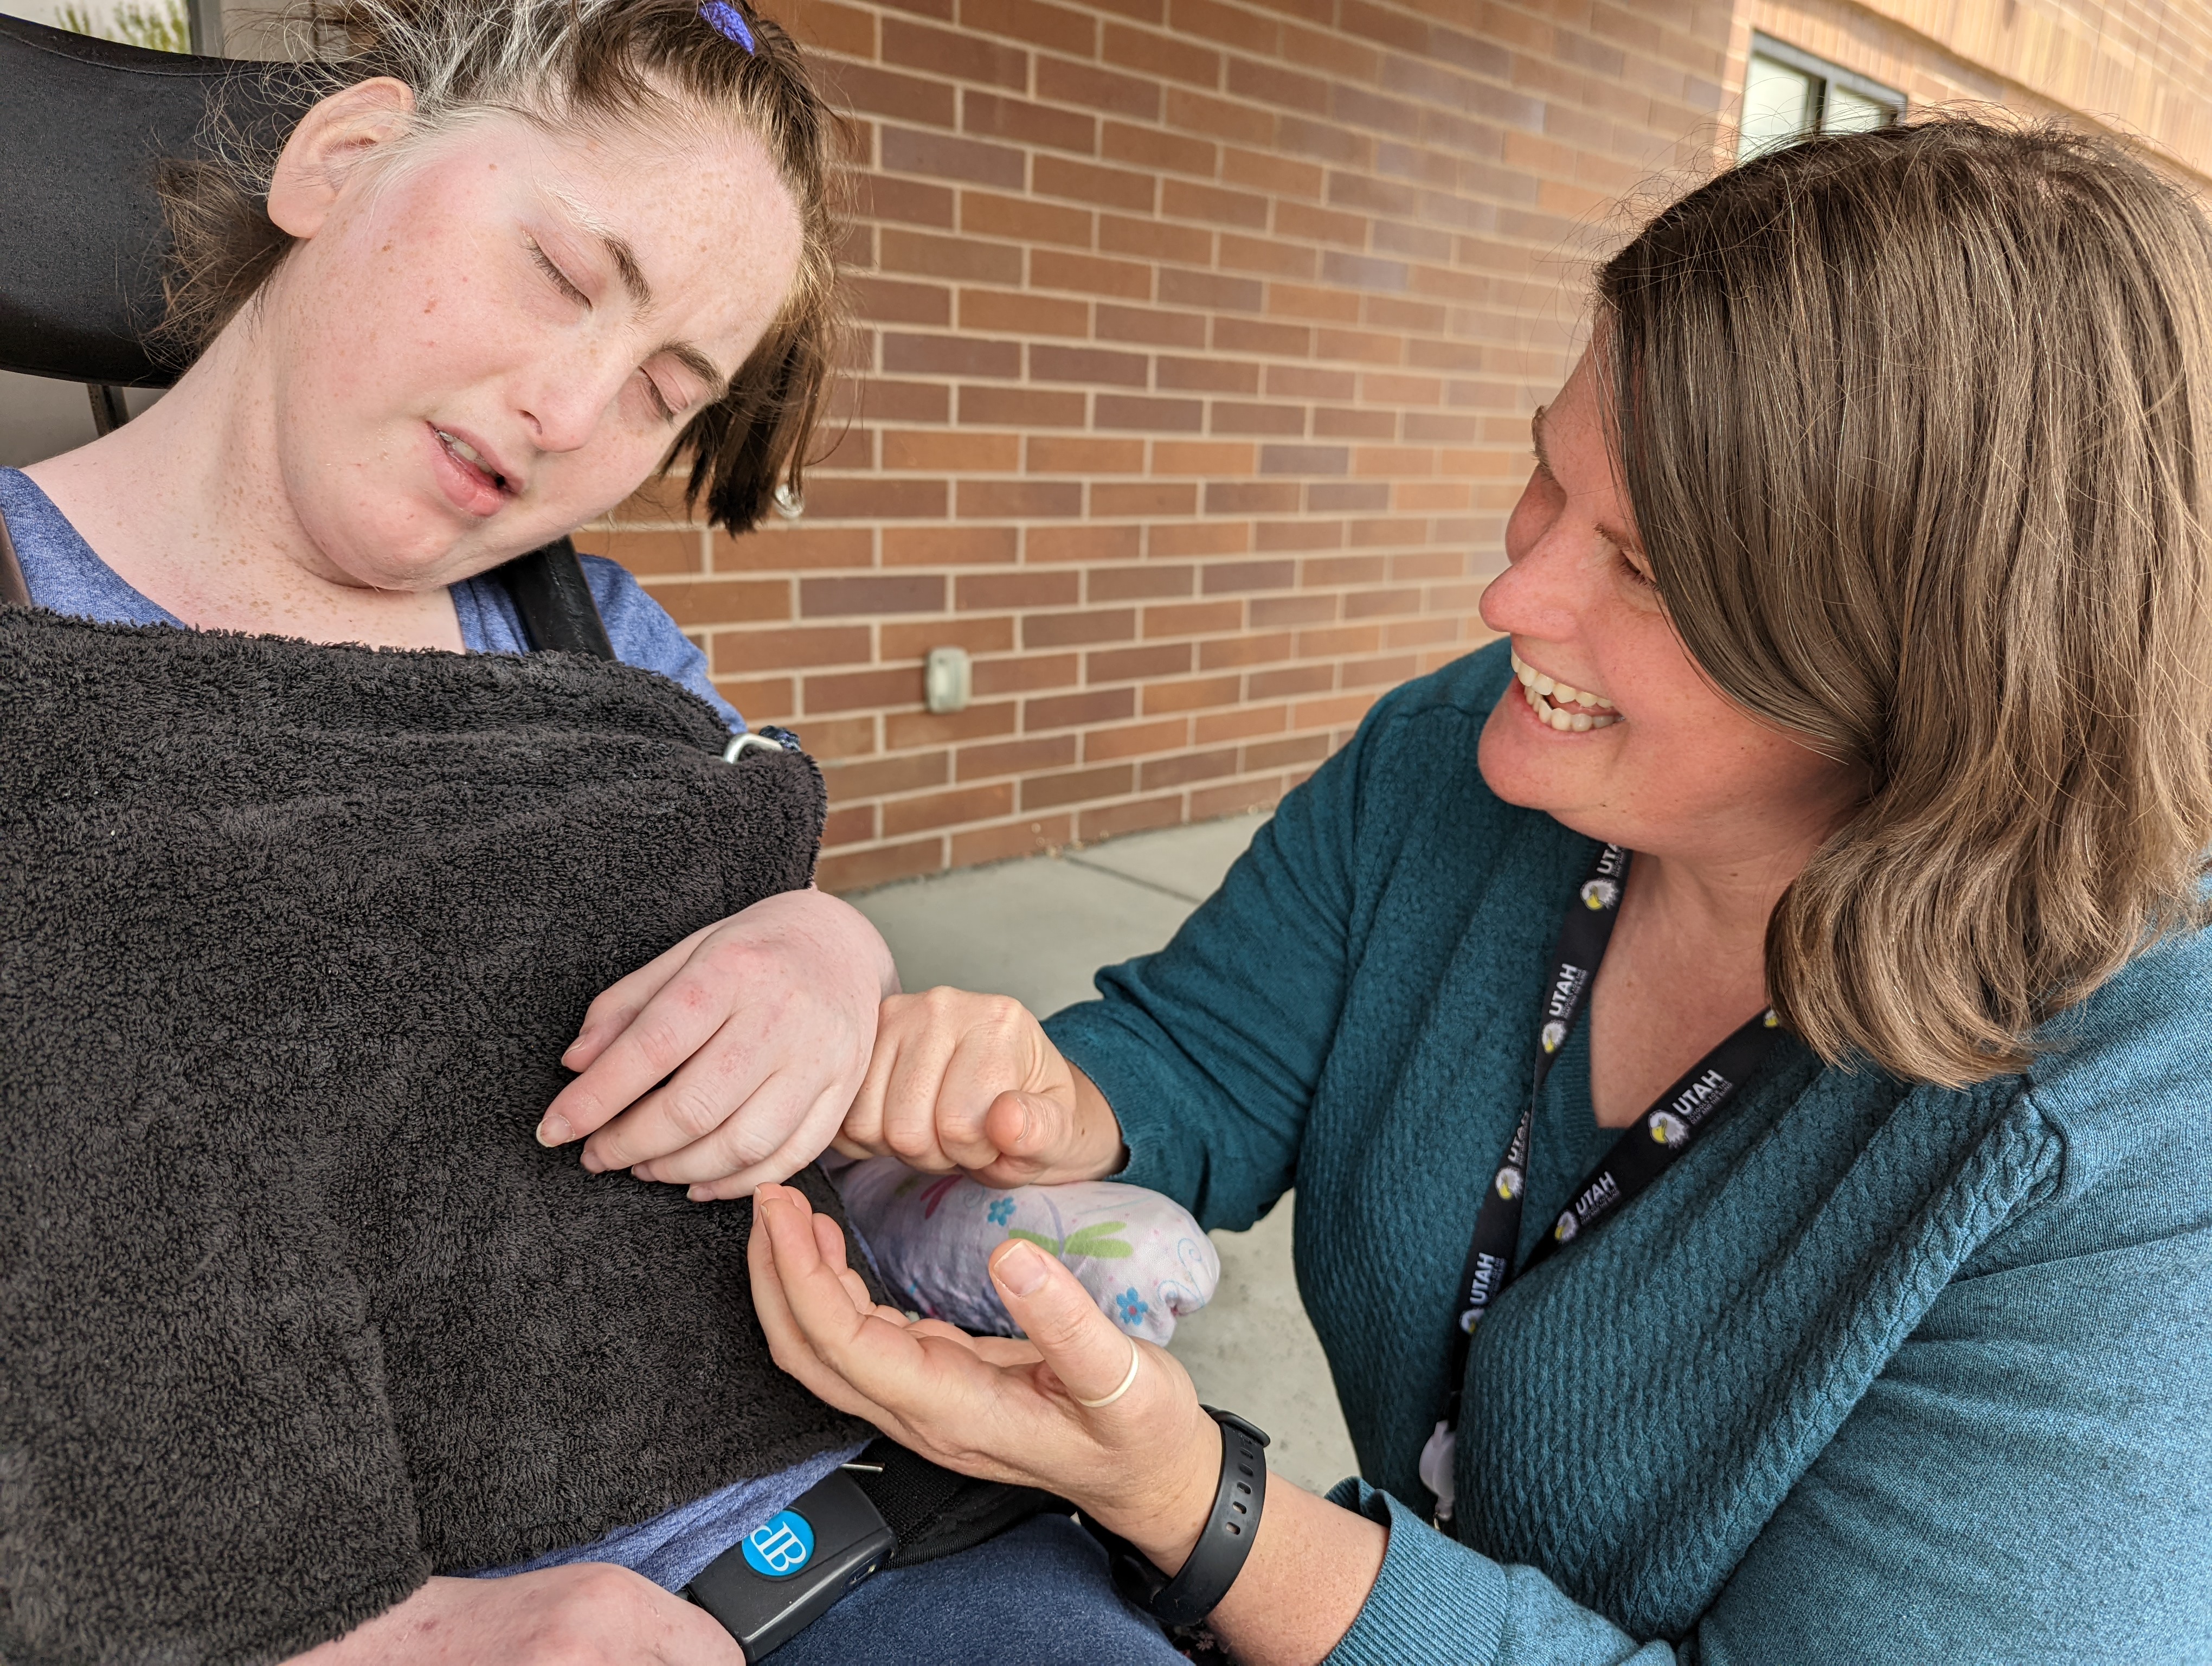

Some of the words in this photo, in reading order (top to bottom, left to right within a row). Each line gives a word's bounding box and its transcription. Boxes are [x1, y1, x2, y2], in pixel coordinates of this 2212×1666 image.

[1548, 963, 1577, 1017] UTAH
[1671, 1068, 1723, 1115] UTAH
[1574, 1170, 1615, 1214] UTAH
[1470, 1252, 1494, 1305] UTAH
